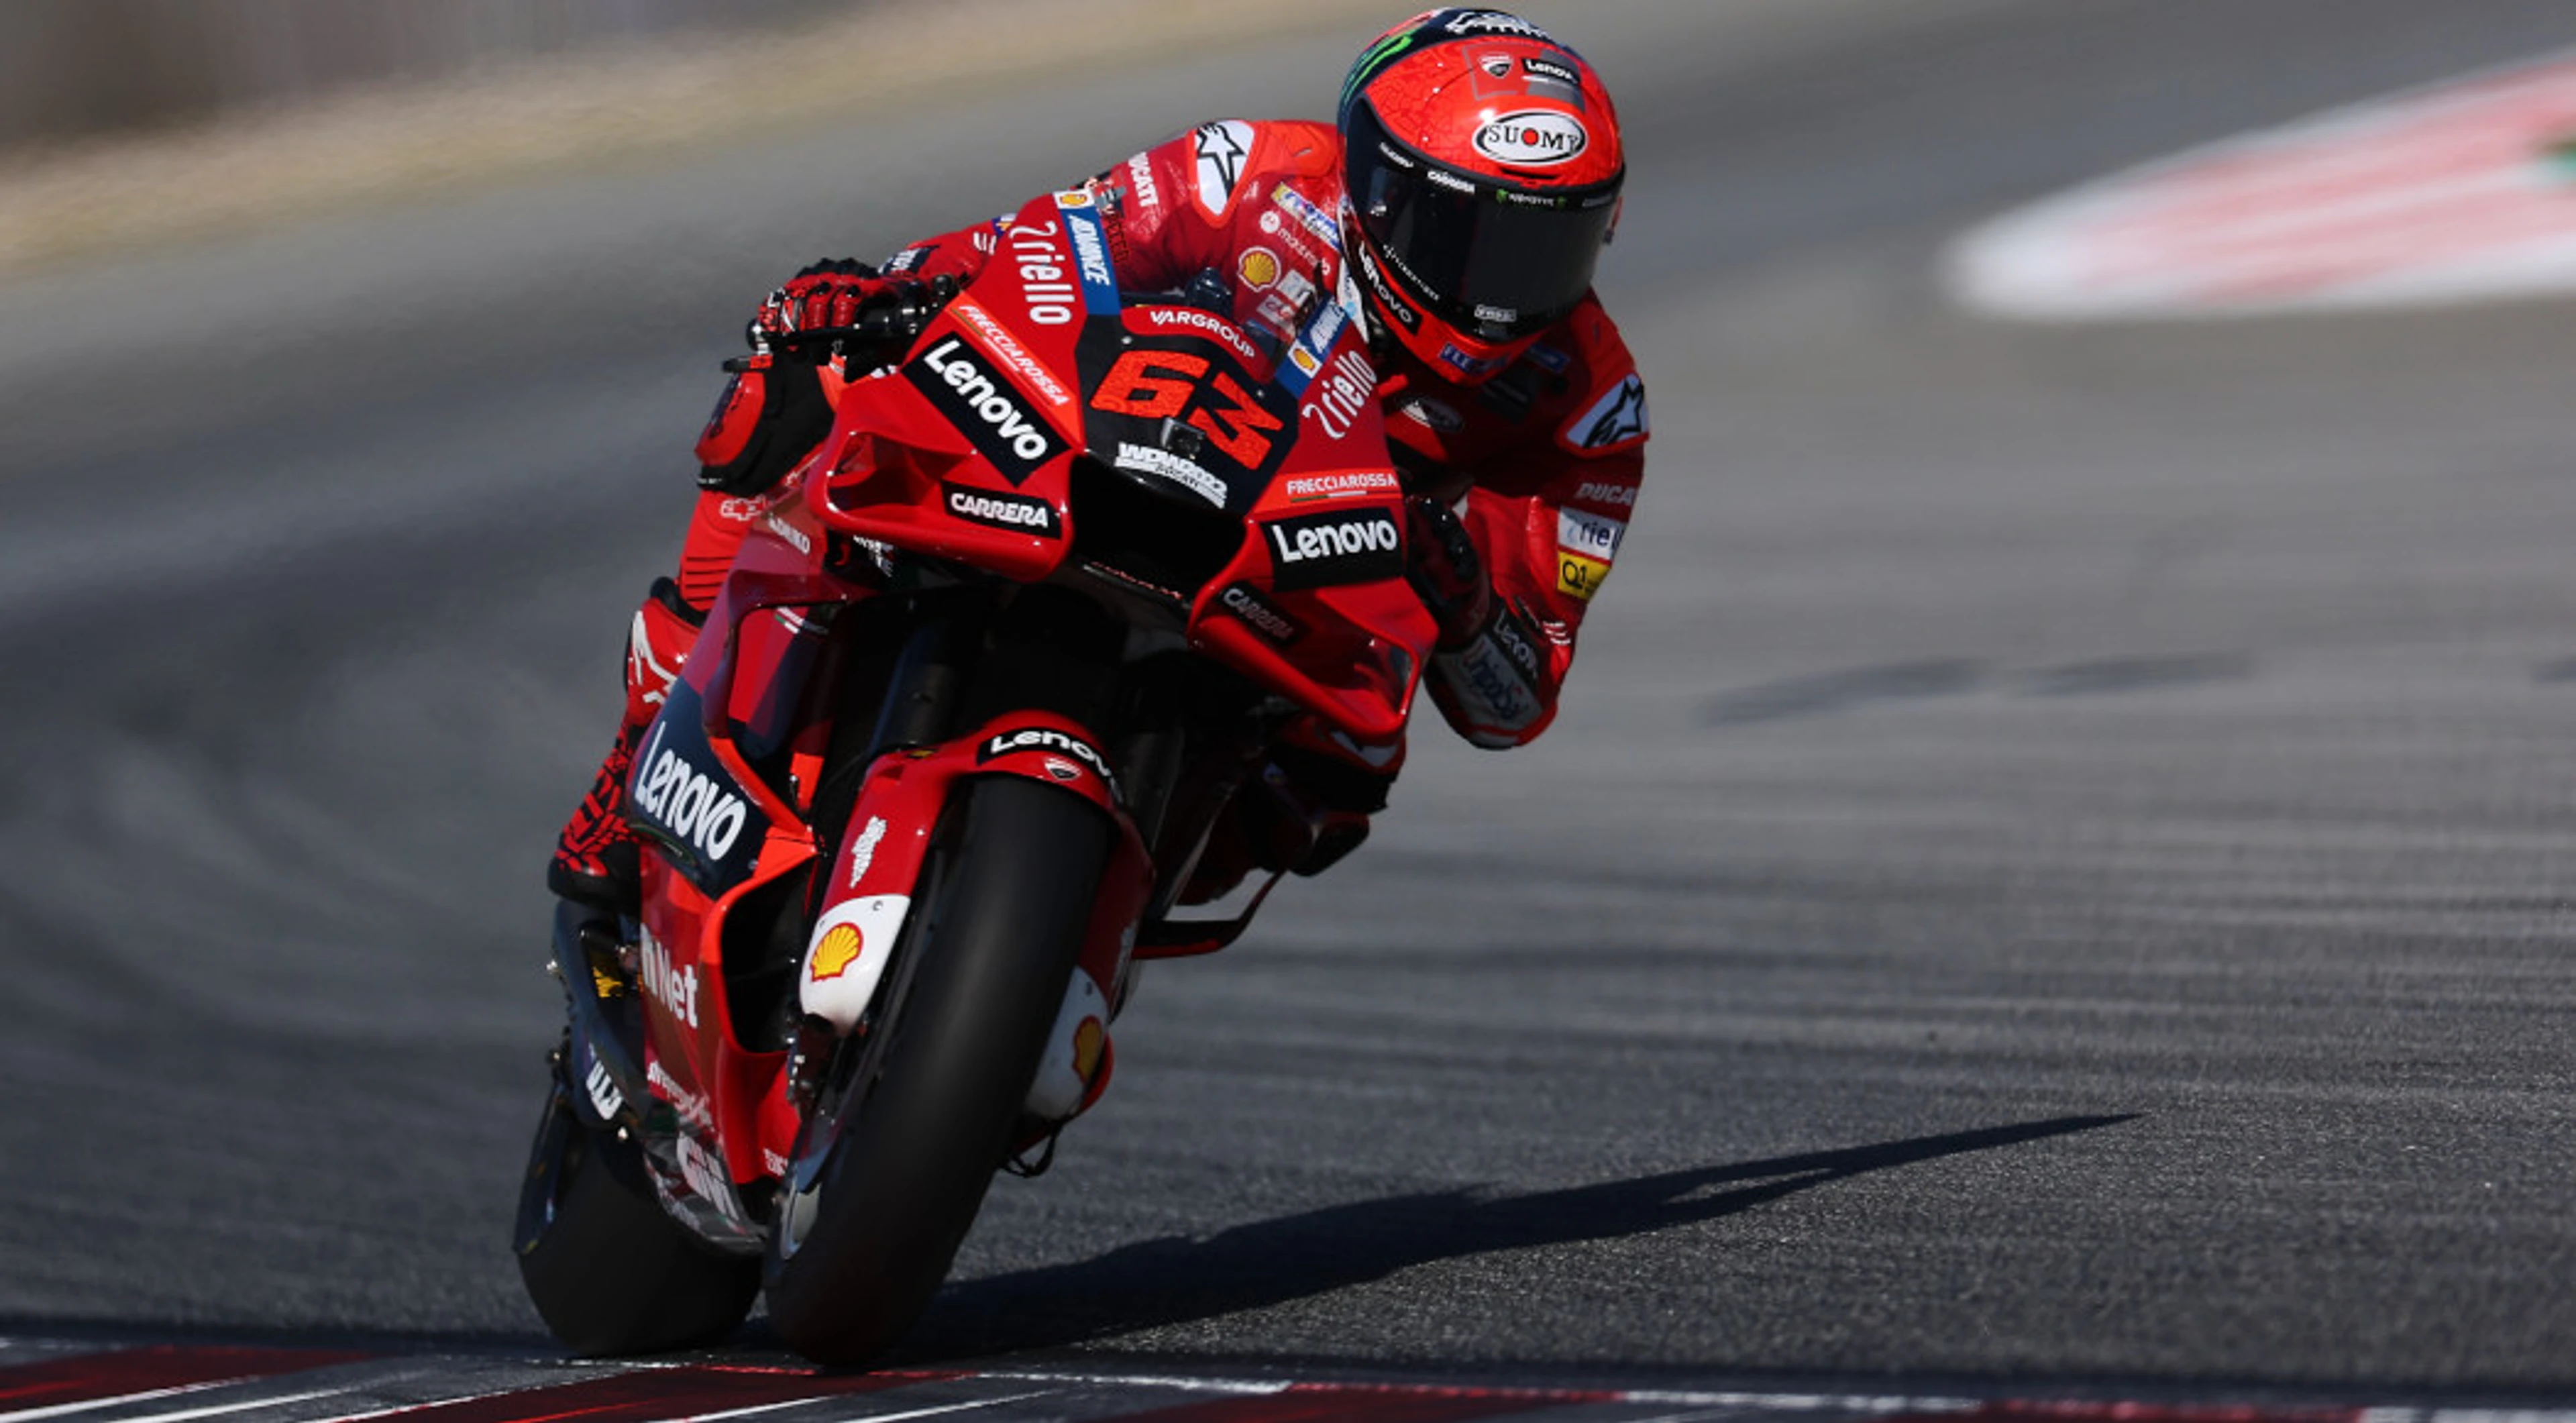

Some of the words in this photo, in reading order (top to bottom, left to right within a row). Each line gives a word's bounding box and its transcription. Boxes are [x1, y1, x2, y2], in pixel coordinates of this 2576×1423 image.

[1488, 125, 1578, 152] SUOMY
[959, 304, 1070, 405] FRECCIAROSSA
[924, 339, 1048, 460] Lenovo
[1089, 350, 1285, 470] 63
[951, 492, 1049, 529] CARRERA
[1287, 473, 1398, 496] FRECCIAROSSA
[1272, 519, 1398, 562] Lenovo
[635, 721, 747, 861] Lenovo
